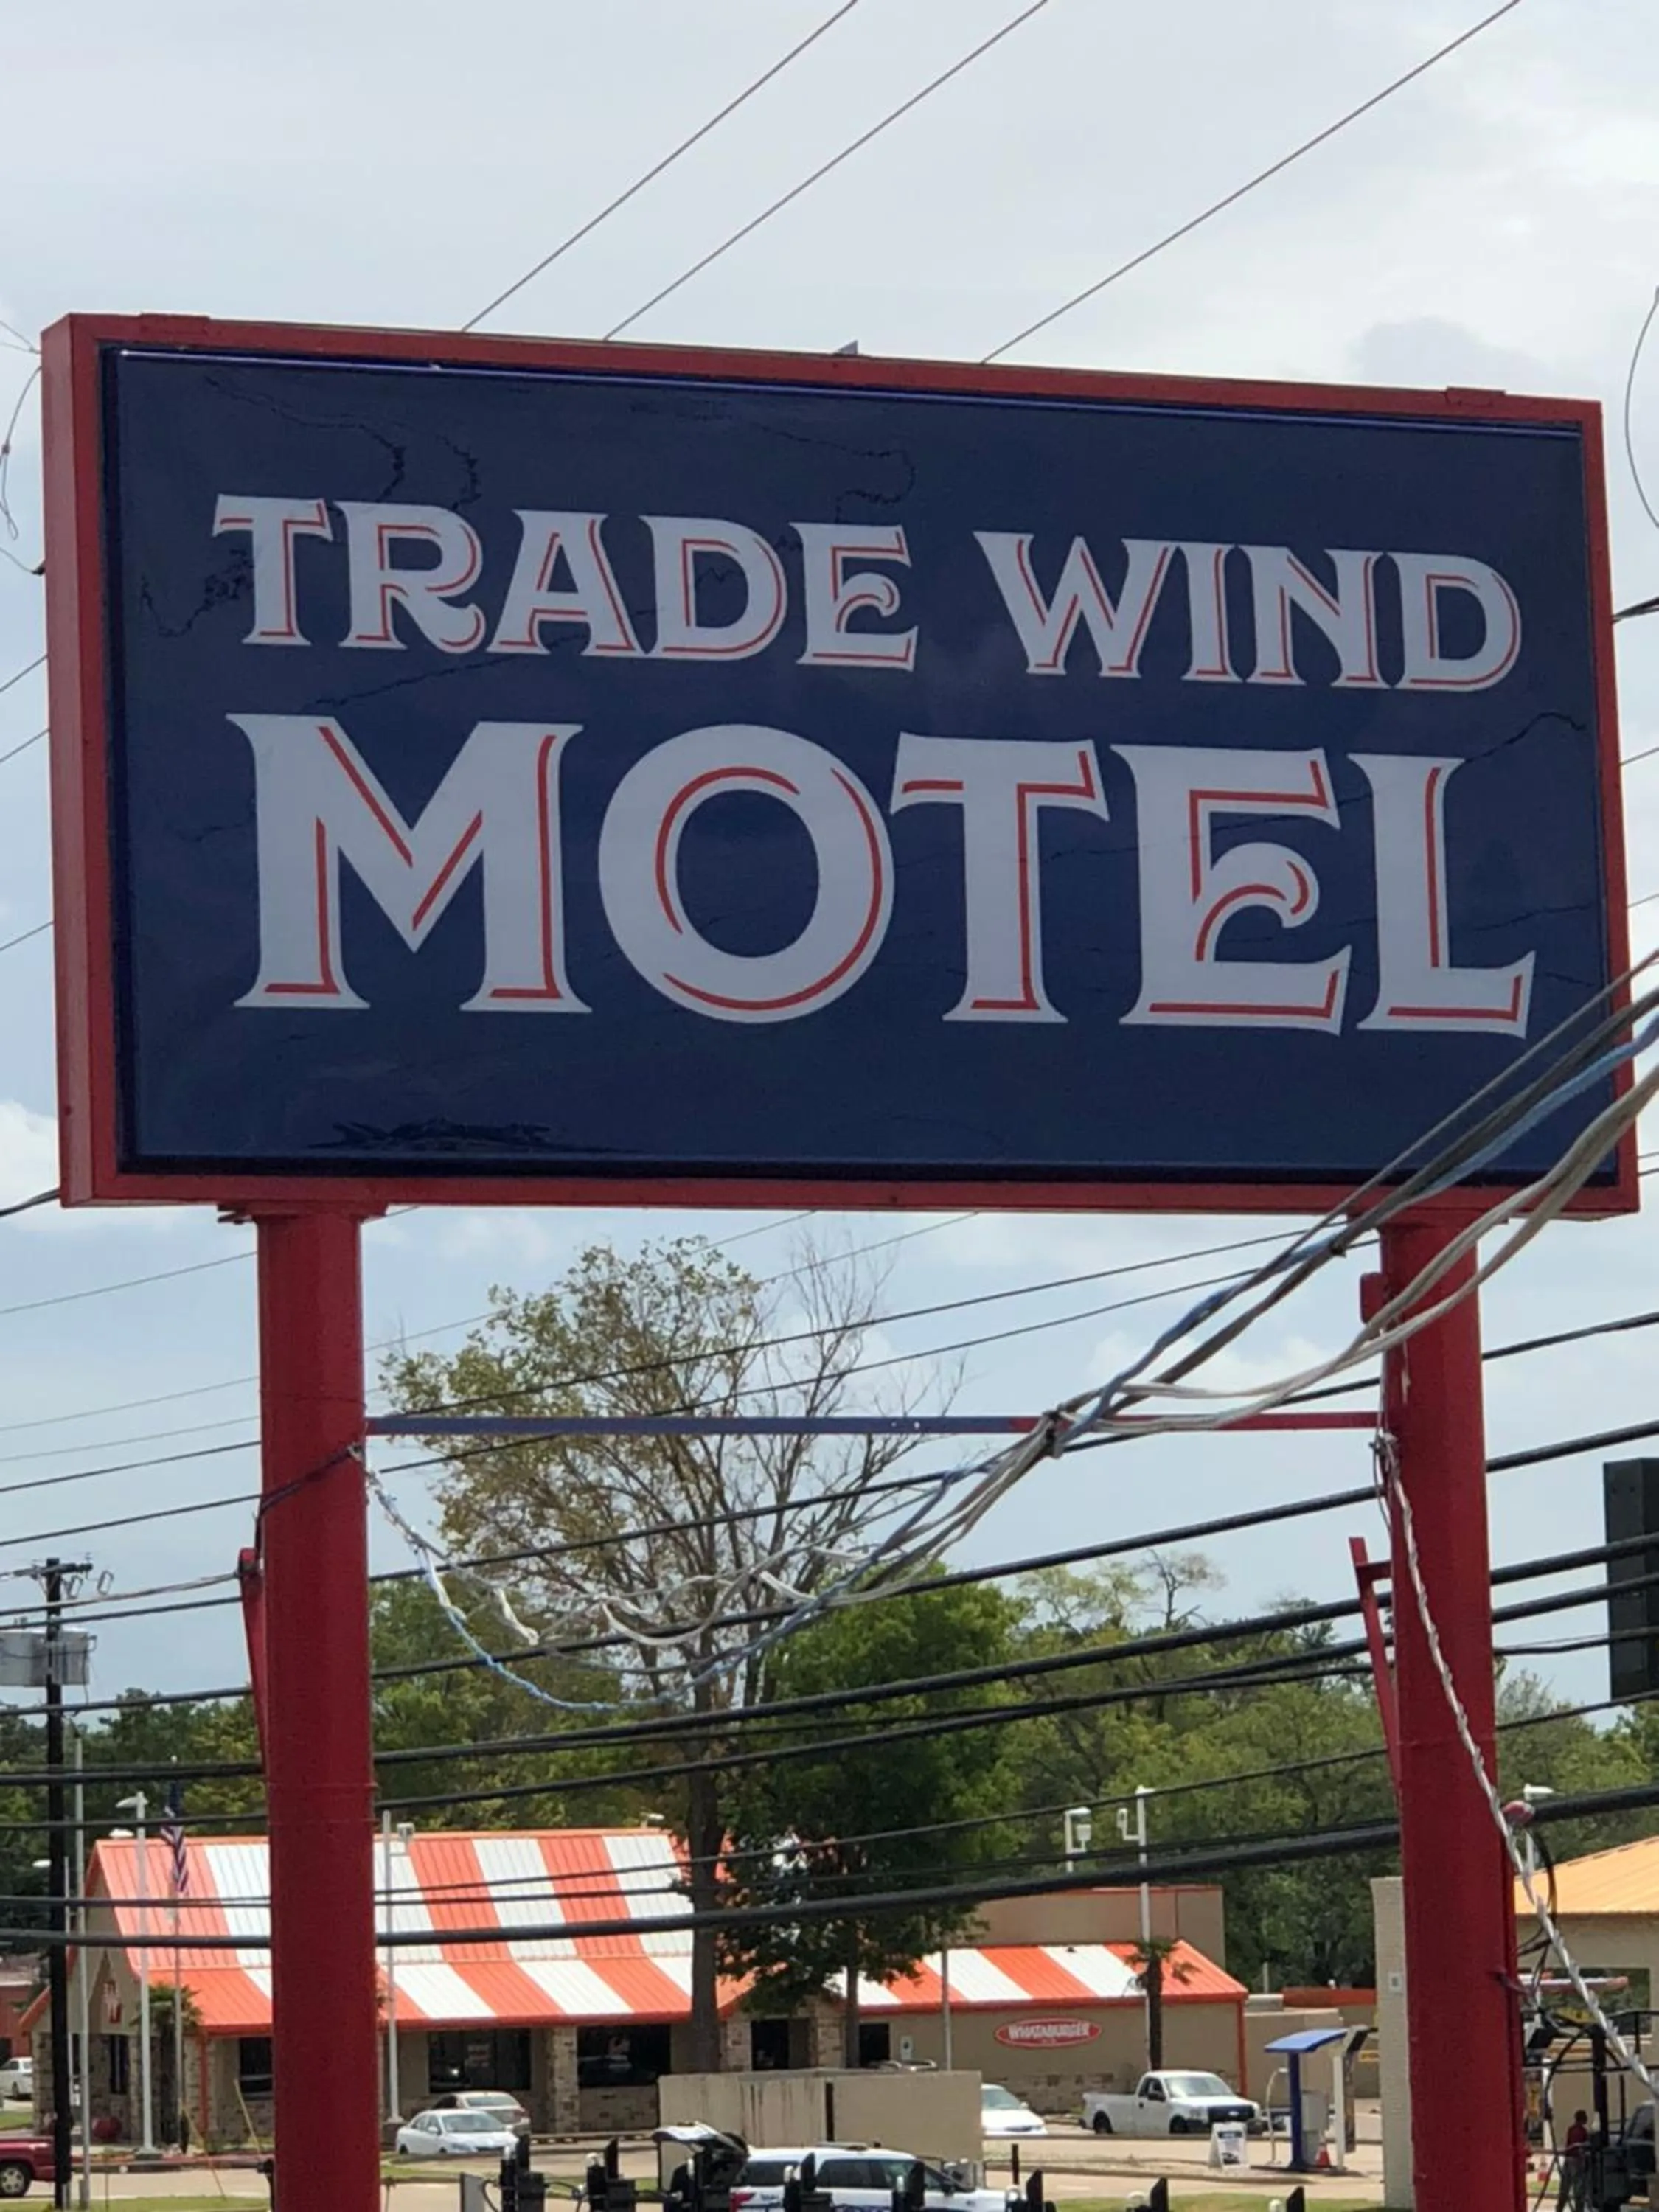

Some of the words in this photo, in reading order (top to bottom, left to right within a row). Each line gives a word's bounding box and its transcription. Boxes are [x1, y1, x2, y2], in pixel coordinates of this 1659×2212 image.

[214, 494, 918, 671] TRADE
[974, 532, 1521, 692] WIND
[227, 714, 1534, 1038] MOTEL
